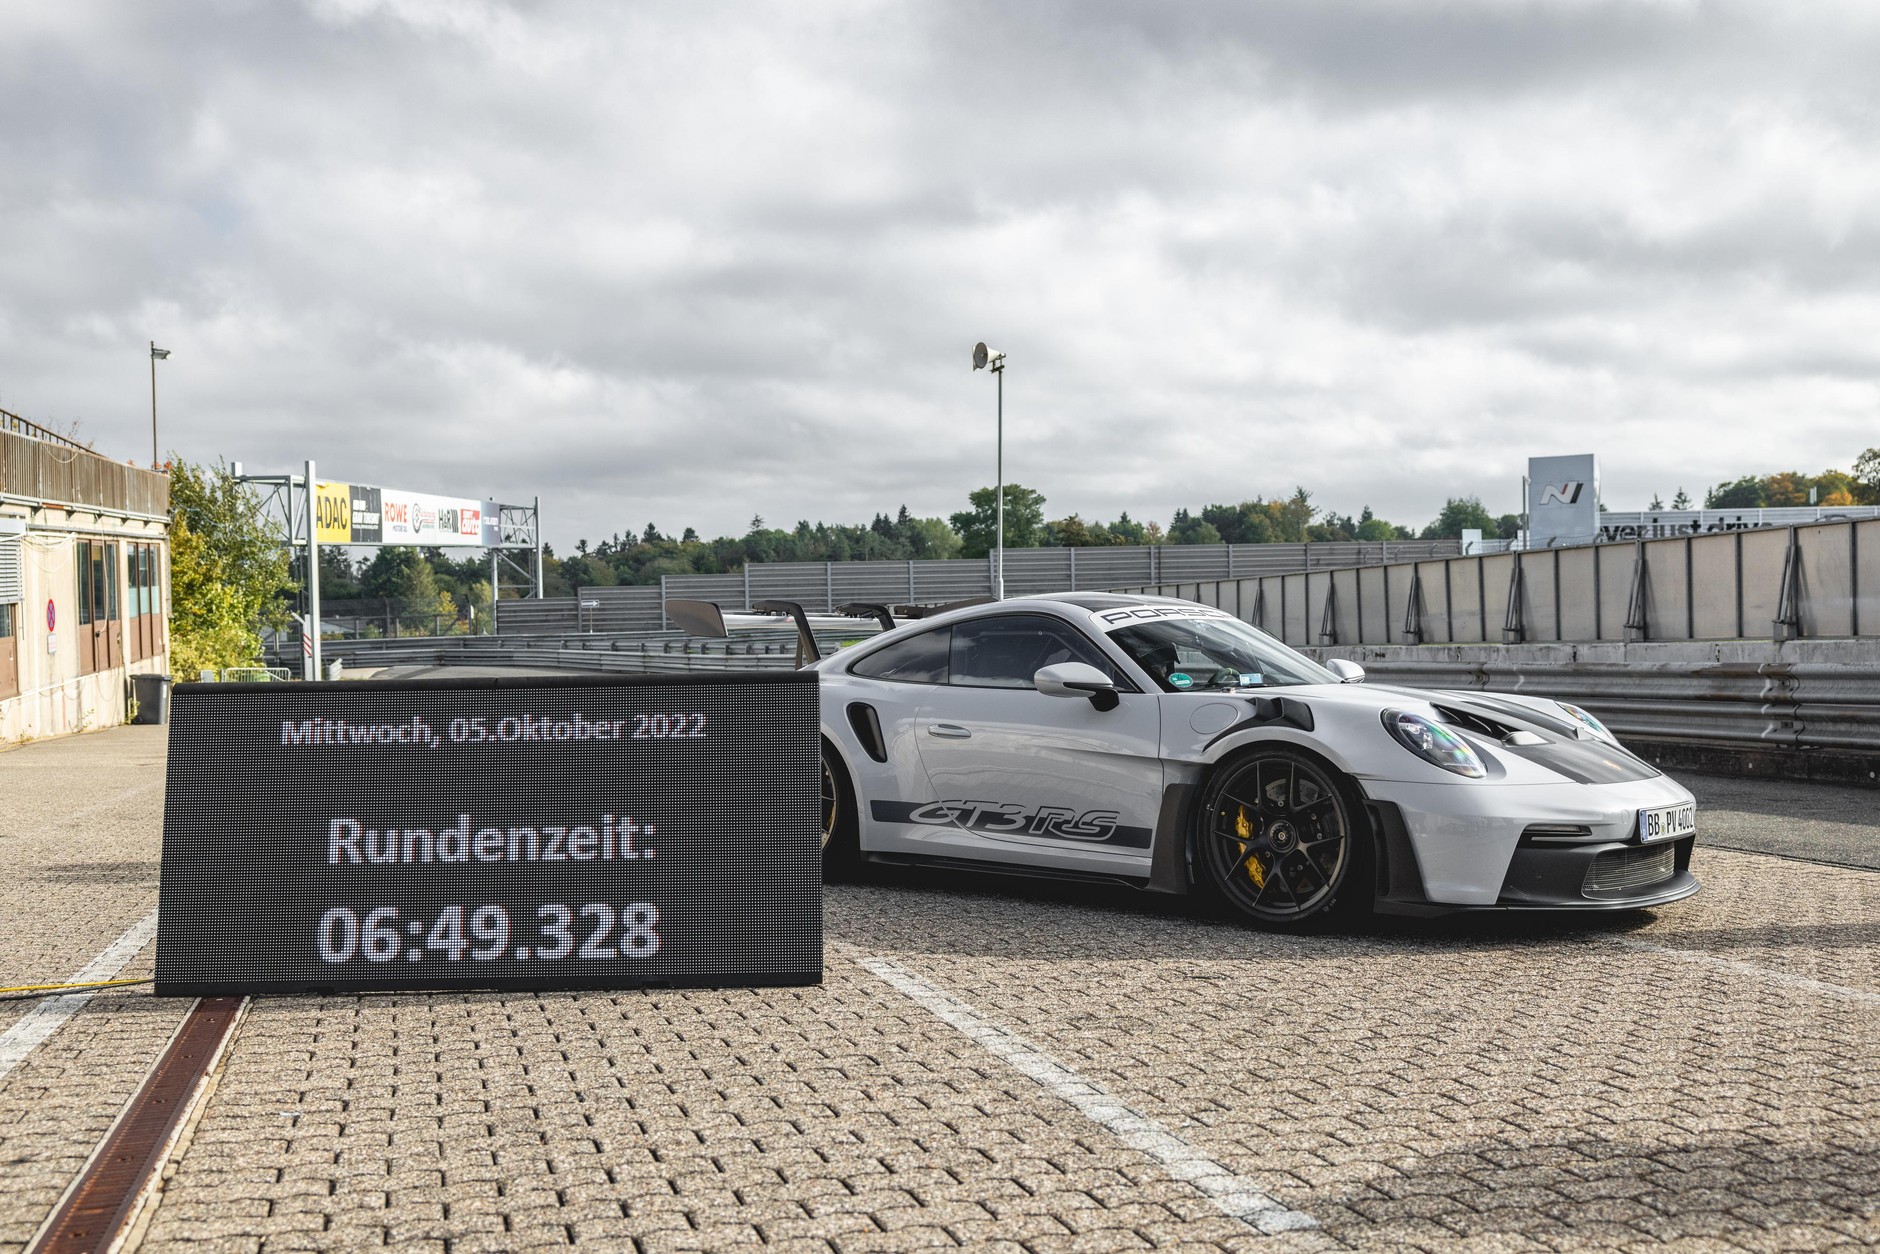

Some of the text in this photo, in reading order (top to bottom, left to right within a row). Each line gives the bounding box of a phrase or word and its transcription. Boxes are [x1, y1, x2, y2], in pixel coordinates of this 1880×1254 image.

[316, 495, 348, 530] ADAC
[384, 502, 407, 523] ROWE
[1101, 608, 1233, 625] PORSC
[281, 713, 707, 748] Mittwoch, 05.Oktober 2022
[328, 814, 657, 864] Rundenzeit:
[1647, 813, 1660, 837] BB
[1666, 810, 1677, 833] PV
[317, 902, 662, 963] 06:49.328
